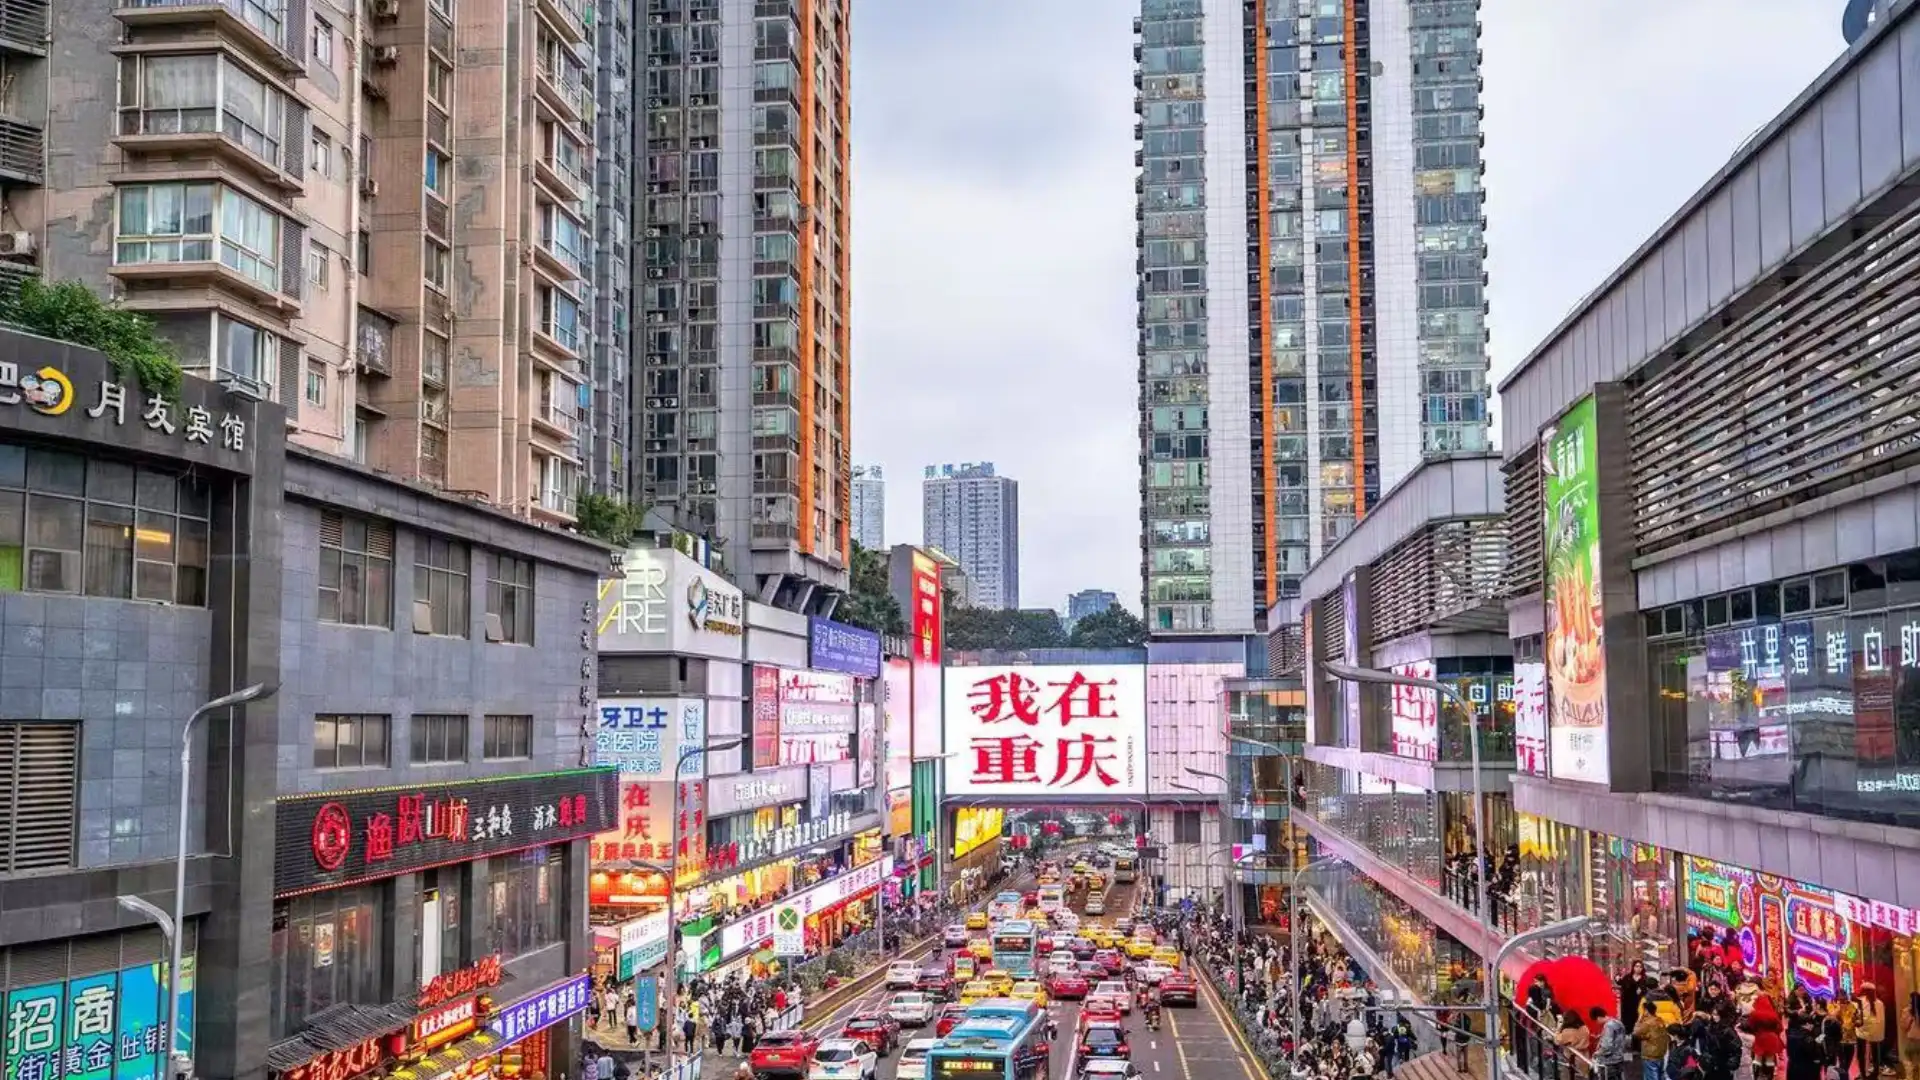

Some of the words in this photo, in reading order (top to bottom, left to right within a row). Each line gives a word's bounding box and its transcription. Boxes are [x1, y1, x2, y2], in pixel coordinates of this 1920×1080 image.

[88, 380, 246, 451] 月友宾馆
[600, 706, 669, 729] 牙卫士
[966, 671, 1119, 727] 我在
[969, 732, 1120, 788] 重庆
[8, 985, 116, 1056] 招商
[504, 981, 586, 1040] 重庆特产烟酒超市
